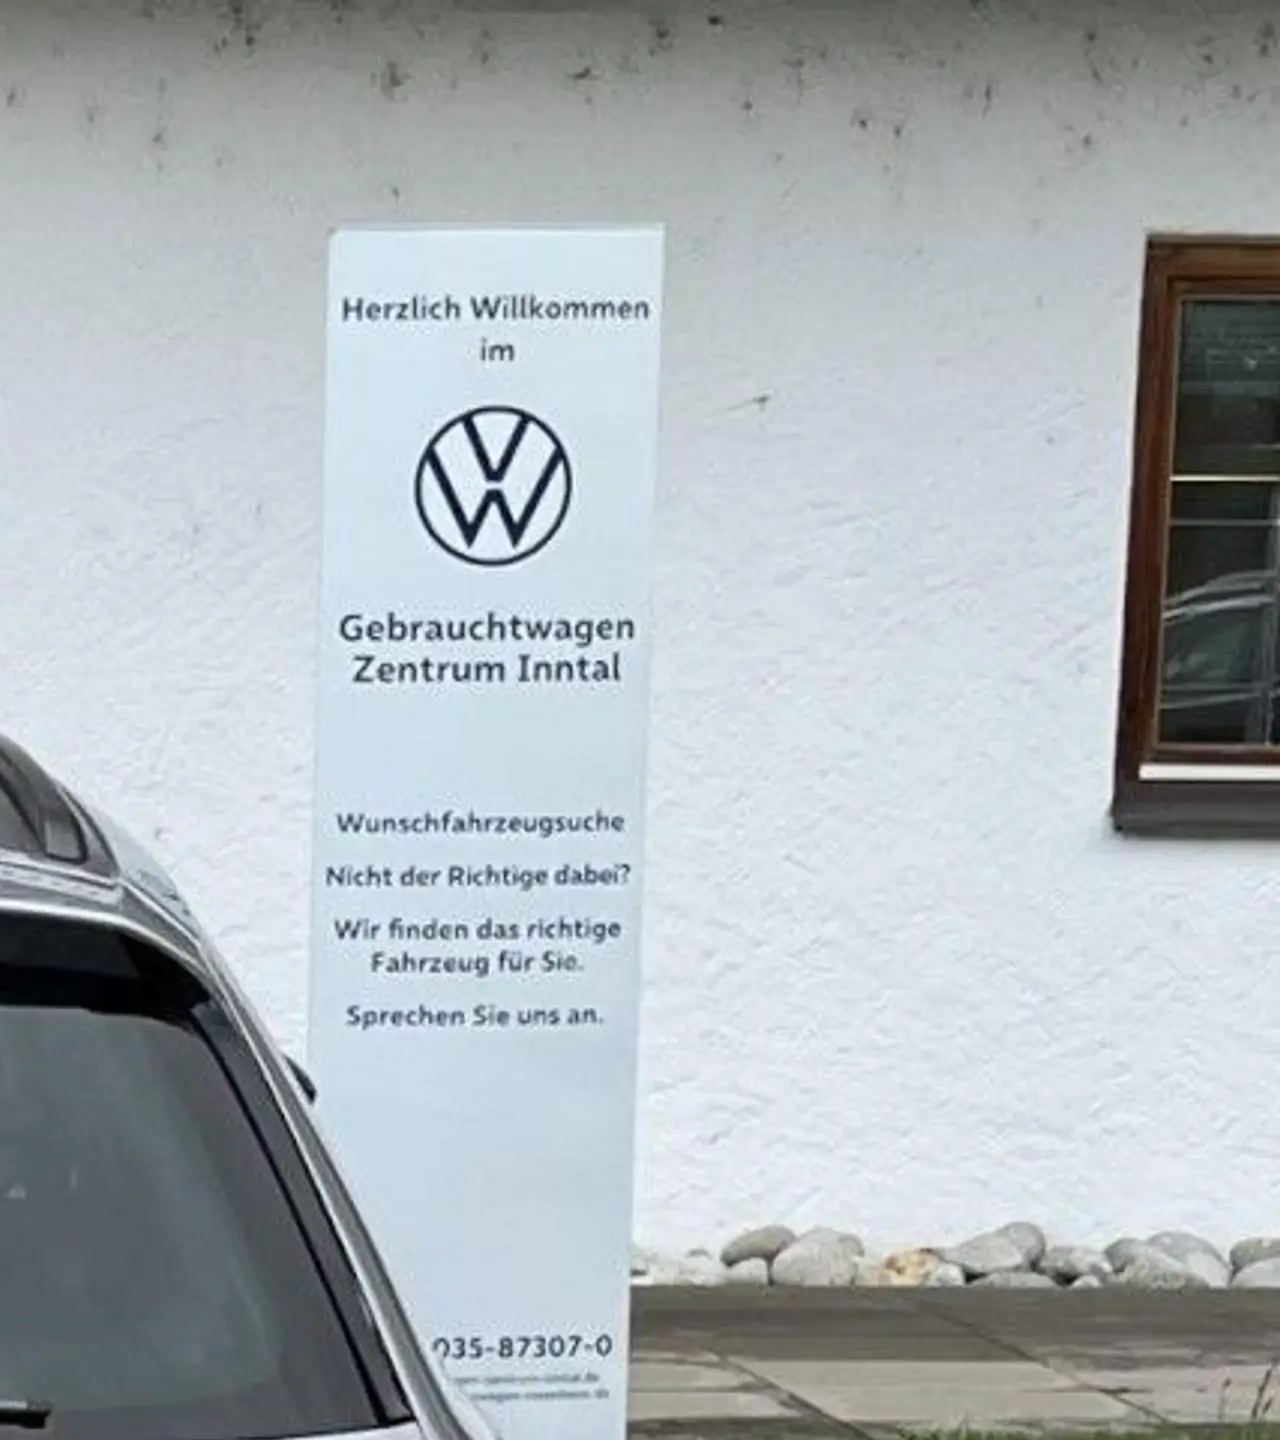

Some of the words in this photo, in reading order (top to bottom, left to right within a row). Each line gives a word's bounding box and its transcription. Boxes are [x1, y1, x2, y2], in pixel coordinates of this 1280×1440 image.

[342, 294, 462, 322] Herzlich
[469, 294, 650, 321] Willkommen
[480, 337, 515, 362] im
[413, 404, 573, 567] VW
[339, 611, 635, 651] Gebrauchtwagen
[352, 654, 506, 684] Zentrum
[517, 653, 621, 683] Inntal
[336, 809, 626, 839] Wunschfahrzeugsuche
[325, 865, 393, 888] Nicht
[399, 865, 442, 888] der
[447, 863, 549, 892] Richtige
[553, 863, 632, 886] dabei?
[333, 918, 381, 941] Wir
[387, 917, 469, 941] finden
[475, 917, 520, 941] das
[526, 915, 622, 945] richtige
[370, 951, 490, 979] Fahrzeug
[497, 949, 536, 973] für
[541, 949, 585, 973] Sie.
[346, 1003, 466, 1031] Sprechen
[472, 1004, 511, 1027] Sie
[516, 1008, 561, 1027] uns
[566, 1007, 604, 1026] an.
[431, 1333, 613, 1361] 035-87307-0
